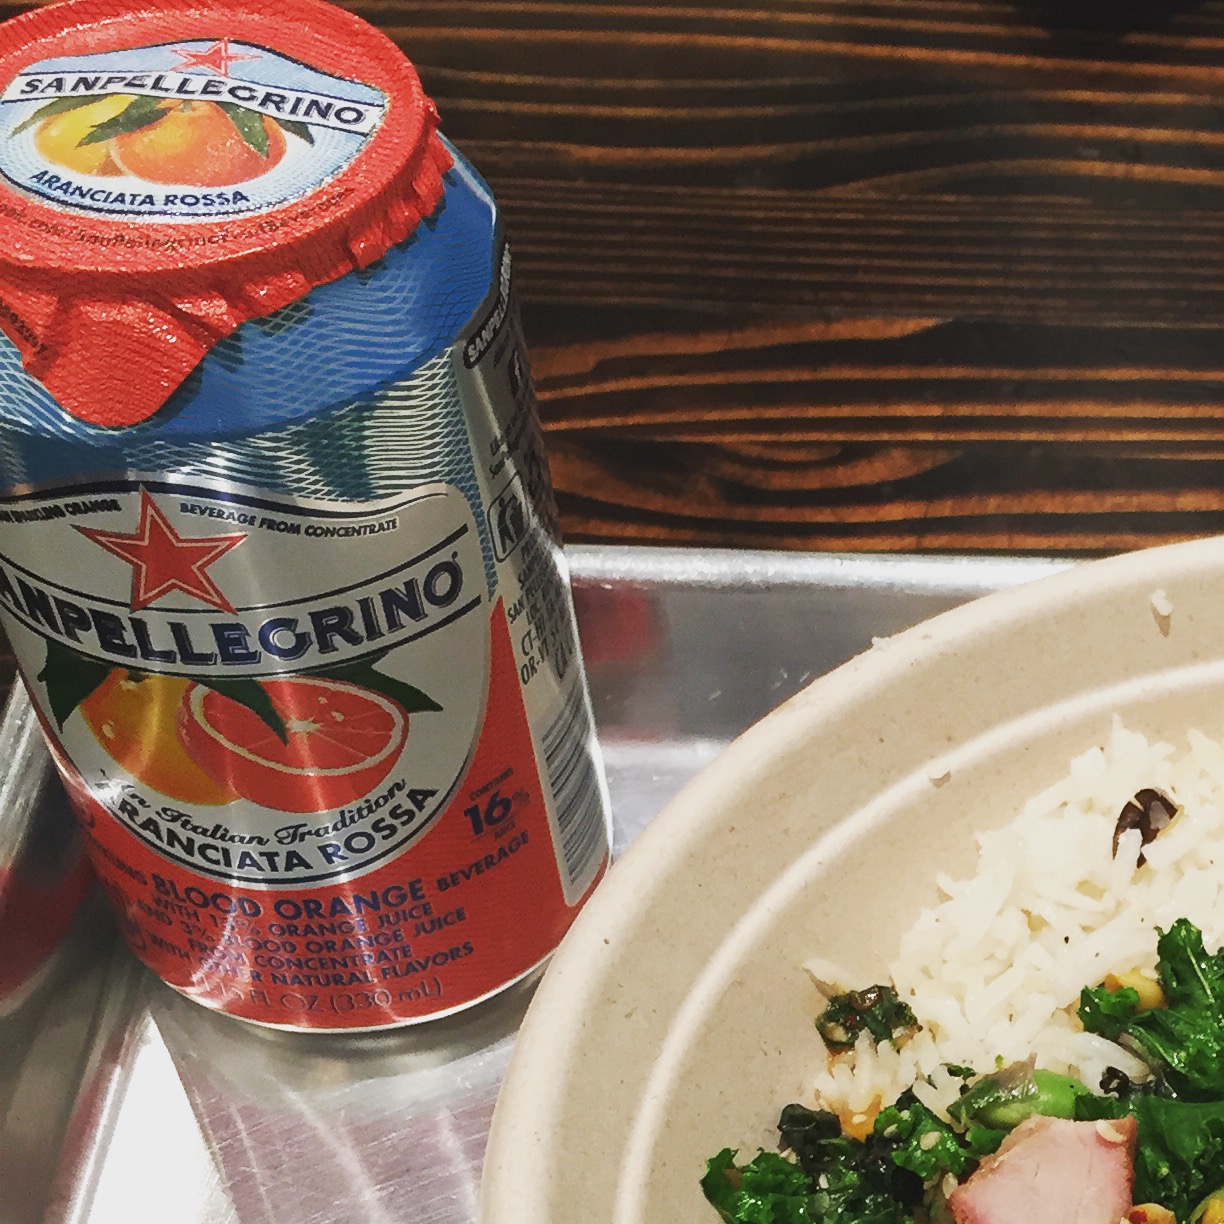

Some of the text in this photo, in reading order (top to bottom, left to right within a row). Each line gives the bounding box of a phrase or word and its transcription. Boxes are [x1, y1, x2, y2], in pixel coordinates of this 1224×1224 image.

[20, 74, 368, 126] SANPELLEGRINO
[29, 170, 251, 207] ARANCIATA ROSSA
[180, 502, 398, 538] BEVERAGE FROM CONCENTRATE
[108, 797, 313, 872] RANCIATA
[317, 788, 440, 865] ROSSA
[155, 806, 270, 847] Italian
[274, 778, 407, 845] Tradition
[436, 829, 529, 893] BEVERAGE
[152, 873, 427, 921] BLOOD ORANGE
[267, 916, 370, 938] ORANGE
[377, 901, 433, 930] JUICE
[304, 928, 405, 954] ORANGE
[413, 906, 467, 938] JUICE
[253, 942, 413, 972] CONCENTRATE
[271, 967, 379, 987] NATURAL
[380, 940, 476, 981] FLAVORS
